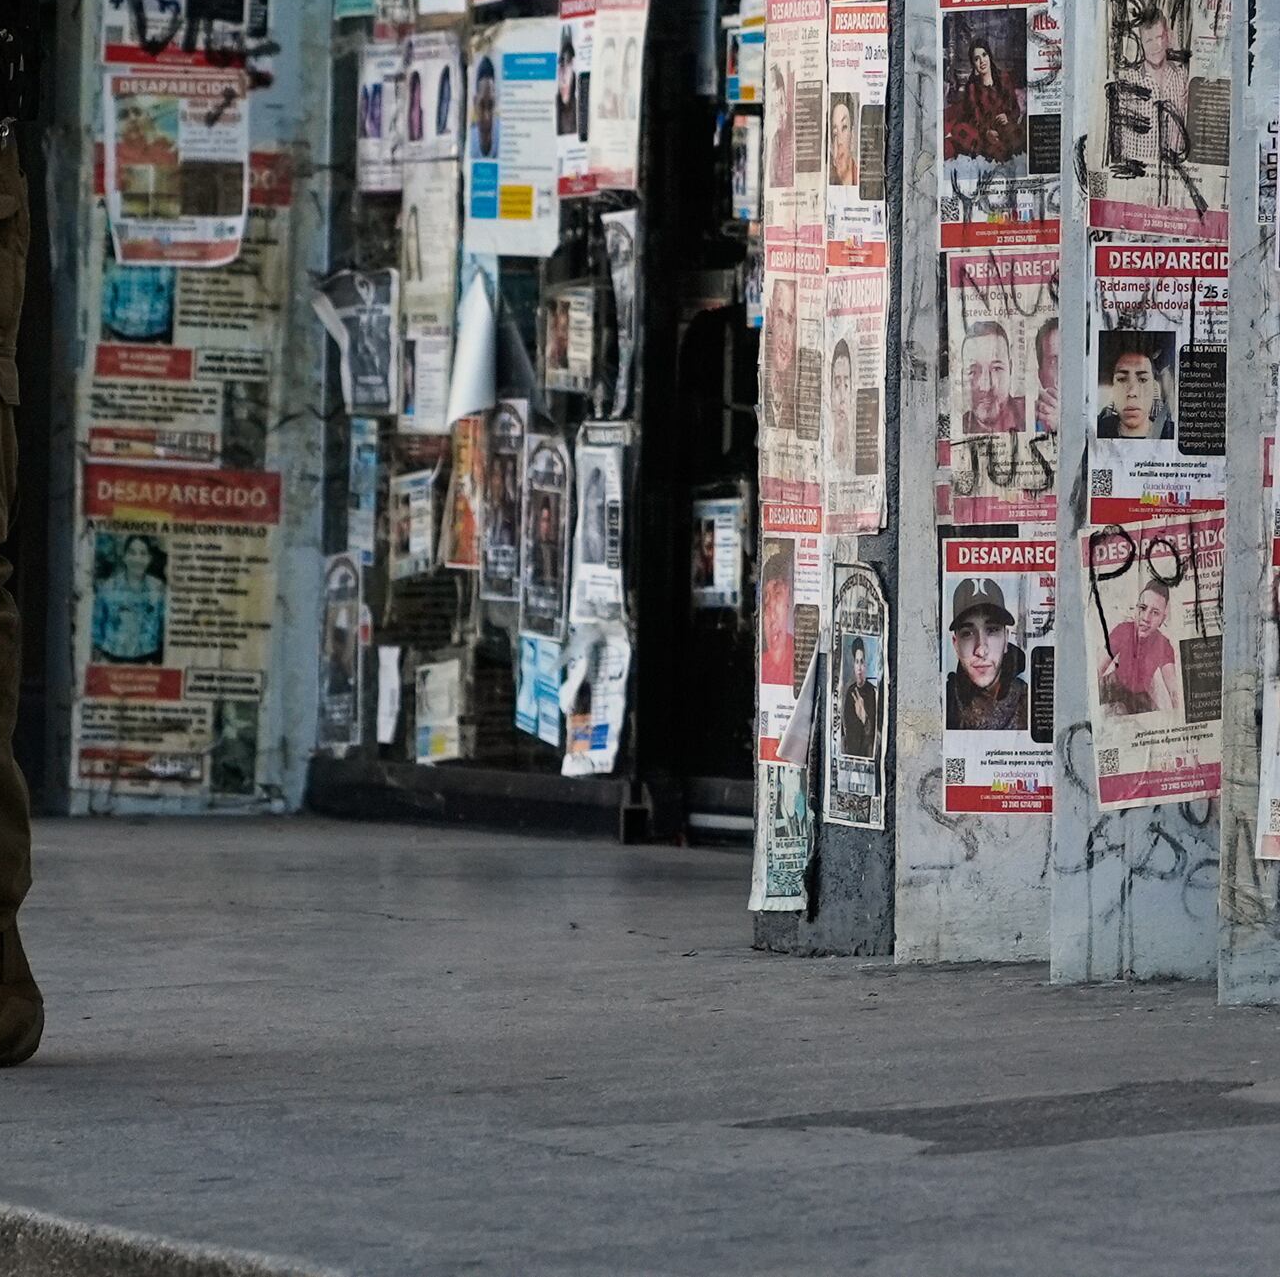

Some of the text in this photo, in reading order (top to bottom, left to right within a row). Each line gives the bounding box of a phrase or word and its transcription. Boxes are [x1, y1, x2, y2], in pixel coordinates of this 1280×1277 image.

[772, 2, 820, 20] DESAPARECIDO
[835, 12, 886, 31] DESAPARECIDO
[1100, 281, 1170, 292] Radames de
[1203, 286, 1219, 298] 25
[101, 480, 266, 507] DESAPARECIDO
[960, 547, 1054, 565] DESAPAREC
